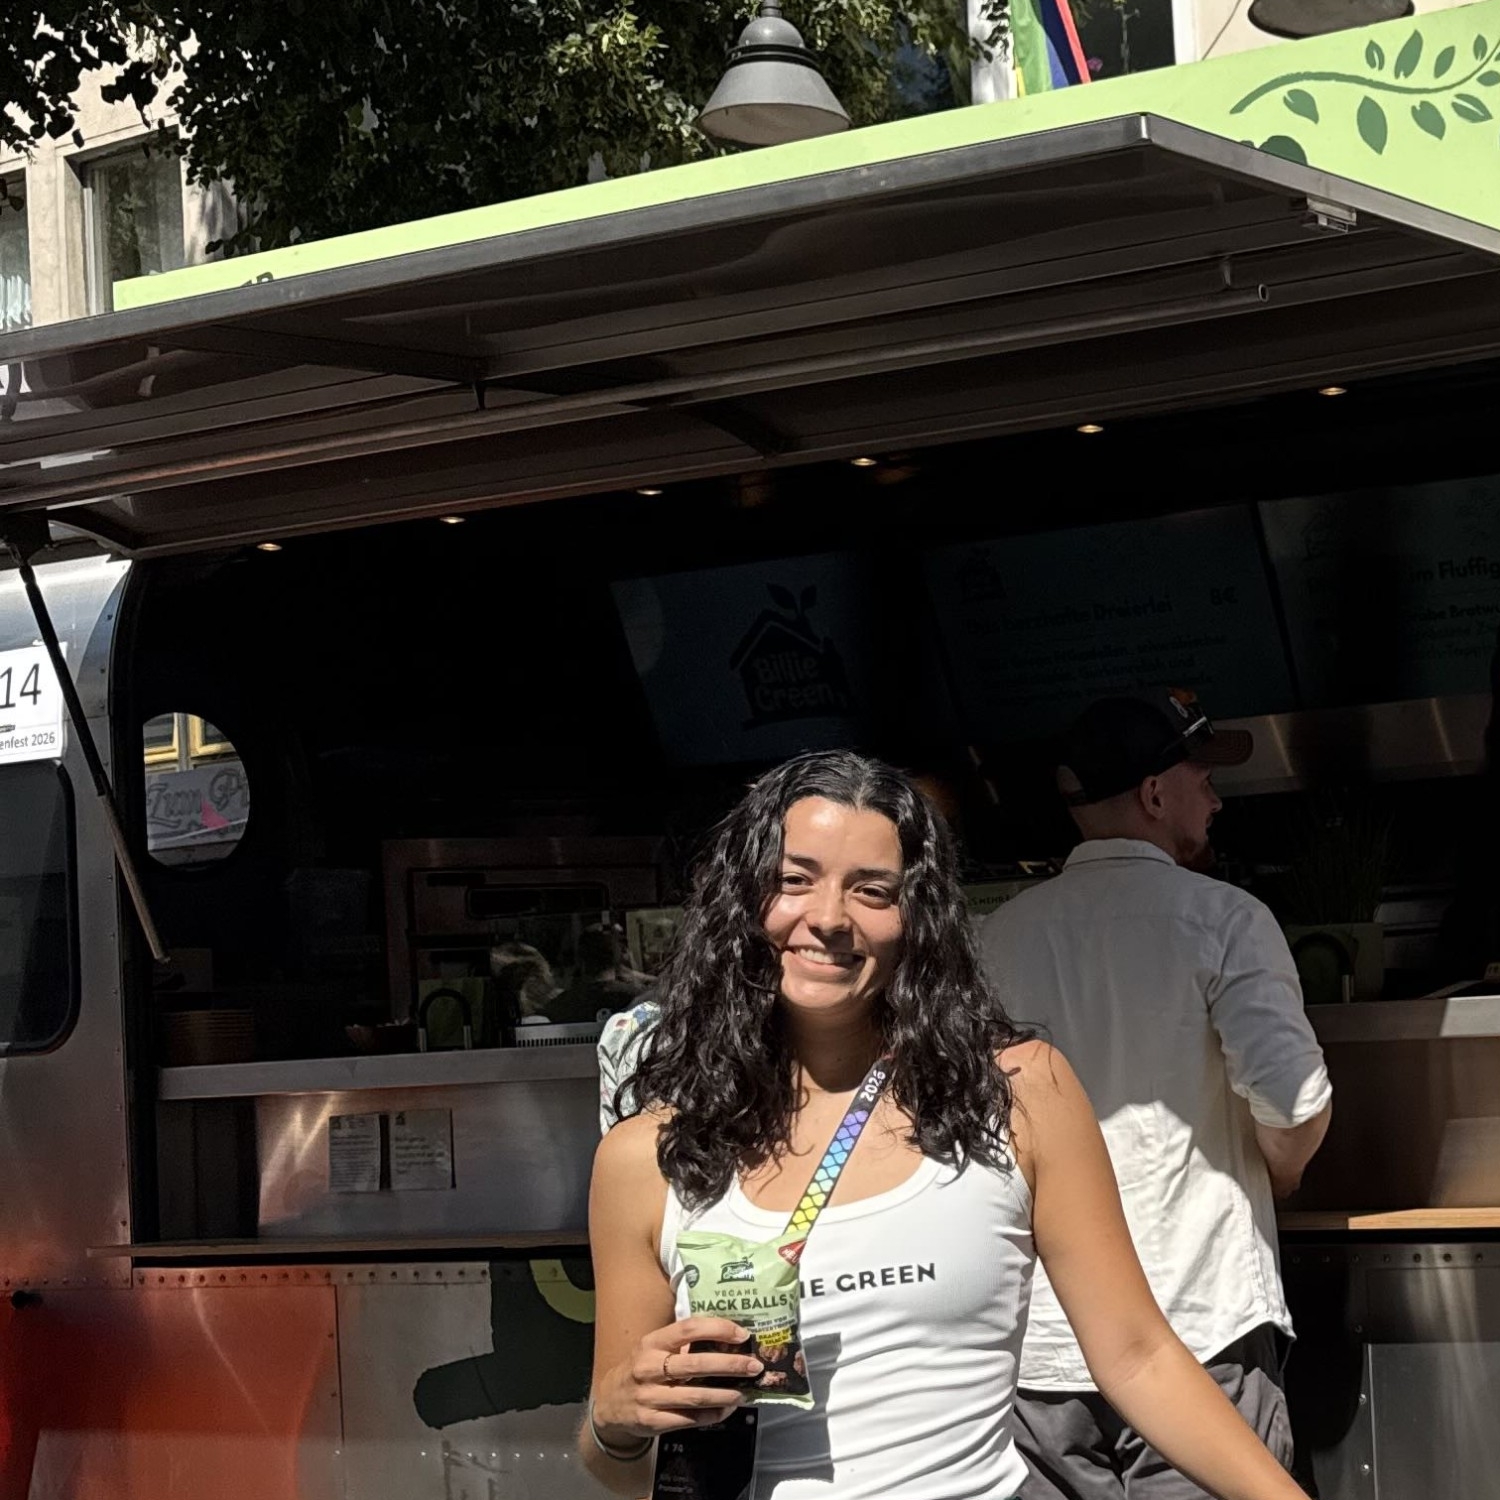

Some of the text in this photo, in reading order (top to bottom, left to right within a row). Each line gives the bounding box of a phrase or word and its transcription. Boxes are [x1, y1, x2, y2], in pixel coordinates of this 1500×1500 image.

[753, 650, 820, 684] Billie
[0, 663, 42, 709] 14
[754, 675, 834, 712] Green
[31, 732, 56, 746] 2026
[860, 1069, 886, 1102] 2026
[836, 1263, 936, 1292] GREEN
[691, 1294, 788, 1313] SNACK BALLS
